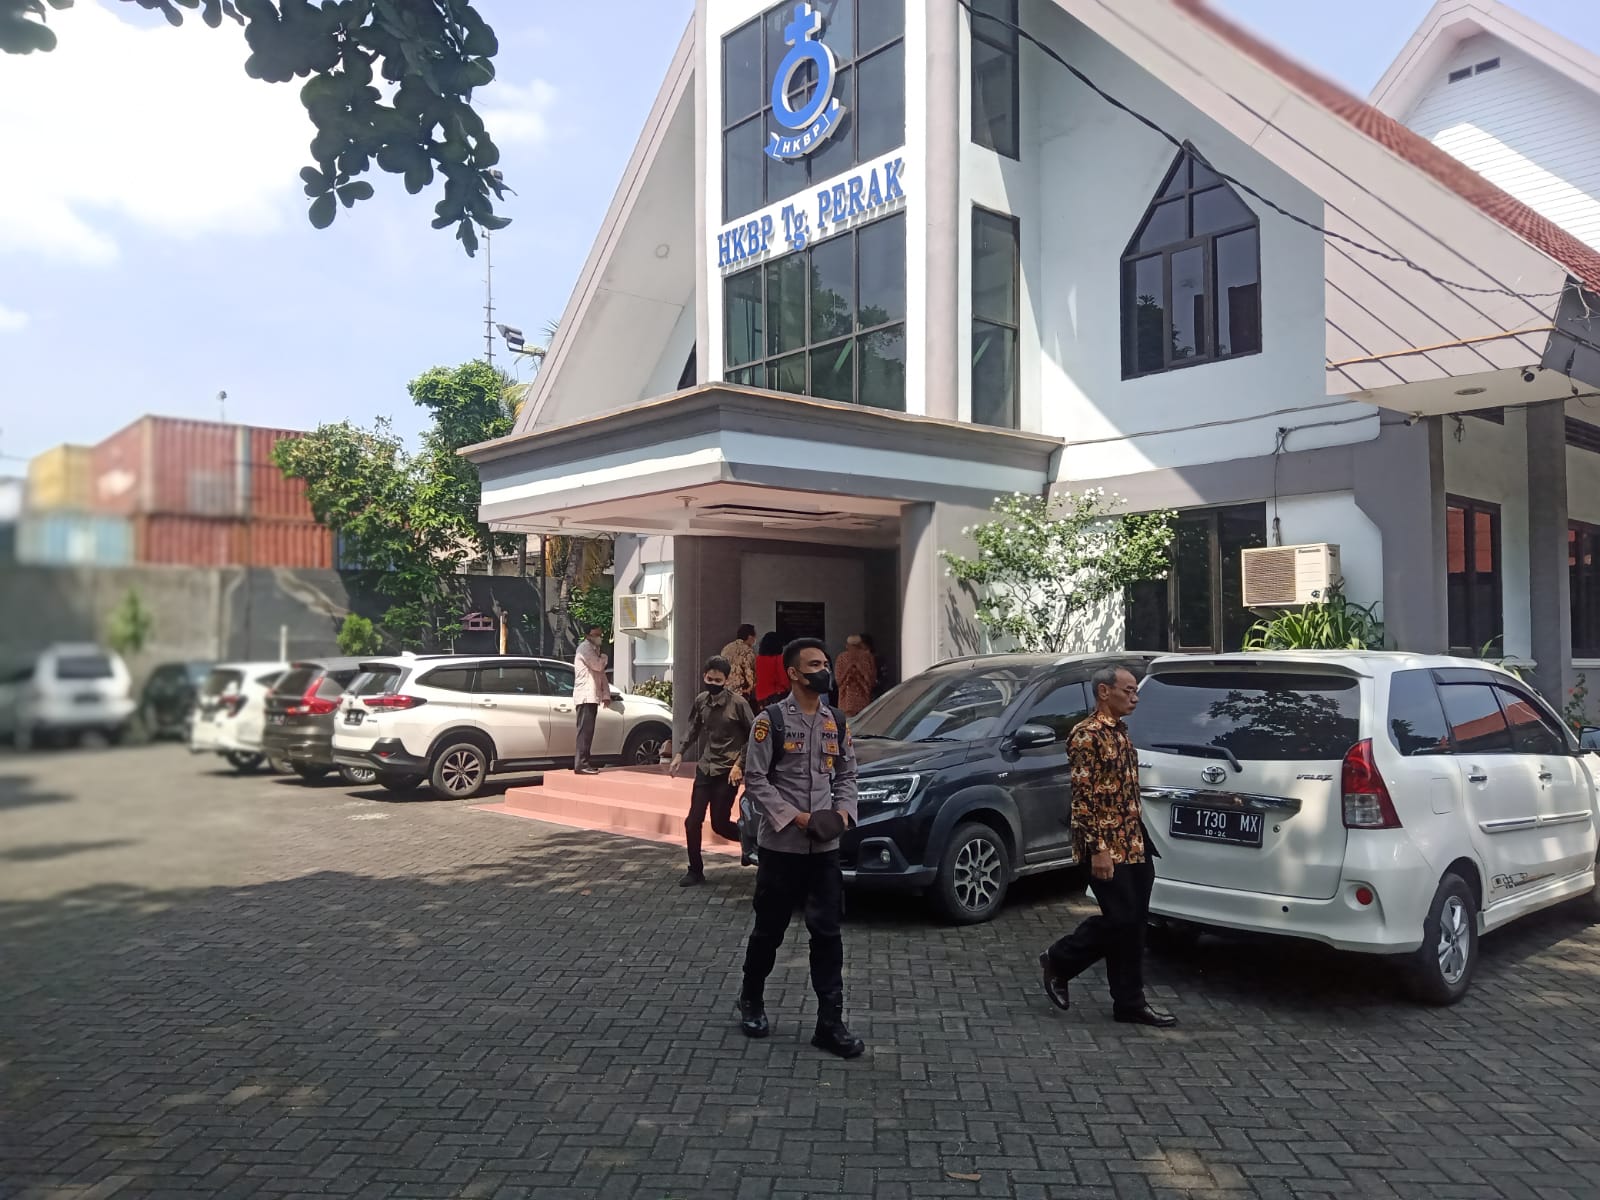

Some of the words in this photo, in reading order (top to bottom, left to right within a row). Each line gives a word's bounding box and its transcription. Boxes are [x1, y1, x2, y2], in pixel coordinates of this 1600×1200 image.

[782, 124, 820, 153] HKBP
[717, 214, 773, 268] HKBP
[780, 203, 810, 250] Tg.
[816, 157, 904, 229] PERAK
[785, 731, 806, 739] AVID
[1173, 808, 1182, 825] L
[1196, 810, 1227, 830] 1730
[1240, 814, 1259, 833] MX
